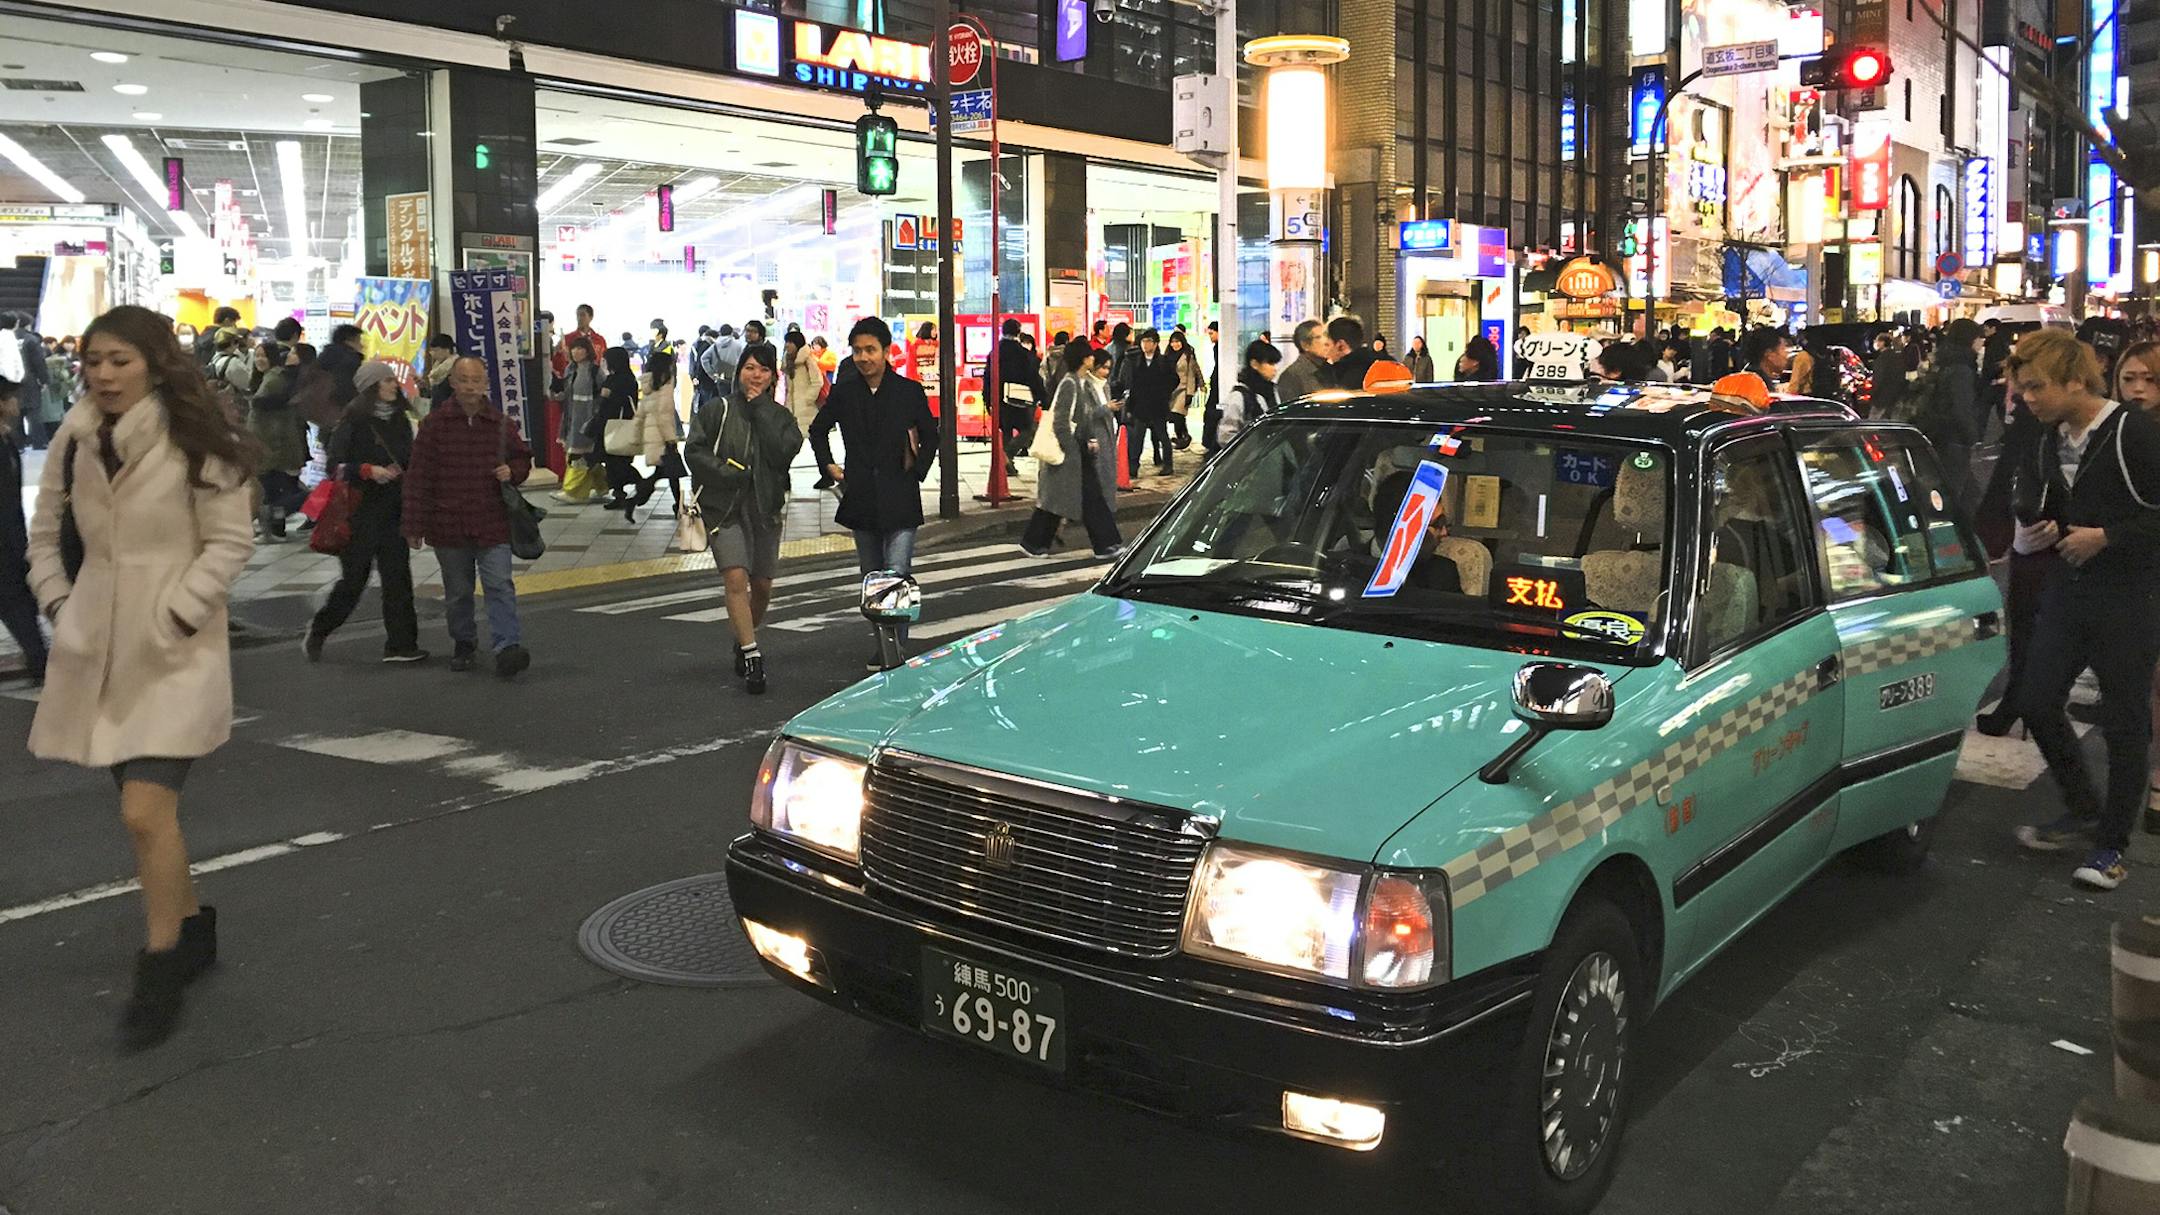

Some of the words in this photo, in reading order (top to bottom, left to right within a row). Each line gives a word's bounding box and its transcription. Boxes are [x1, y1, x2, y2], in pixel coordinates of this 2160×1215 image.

[1706, 44, 1775, 65] 道玄坂二丁目東
[1942, 282, 1953, 298] P
[1526, 340, 1578, 357] グリーン
[1536, 365, 1567, 378] 389
[1505, 576, 1564, 609] 支払
[954, 962, 991, 993] 練馬
[994, 973, 1031, 1005] 500
[934, 994, 945, 1016] う
[952, 992, 1056, 1061] 69-87
